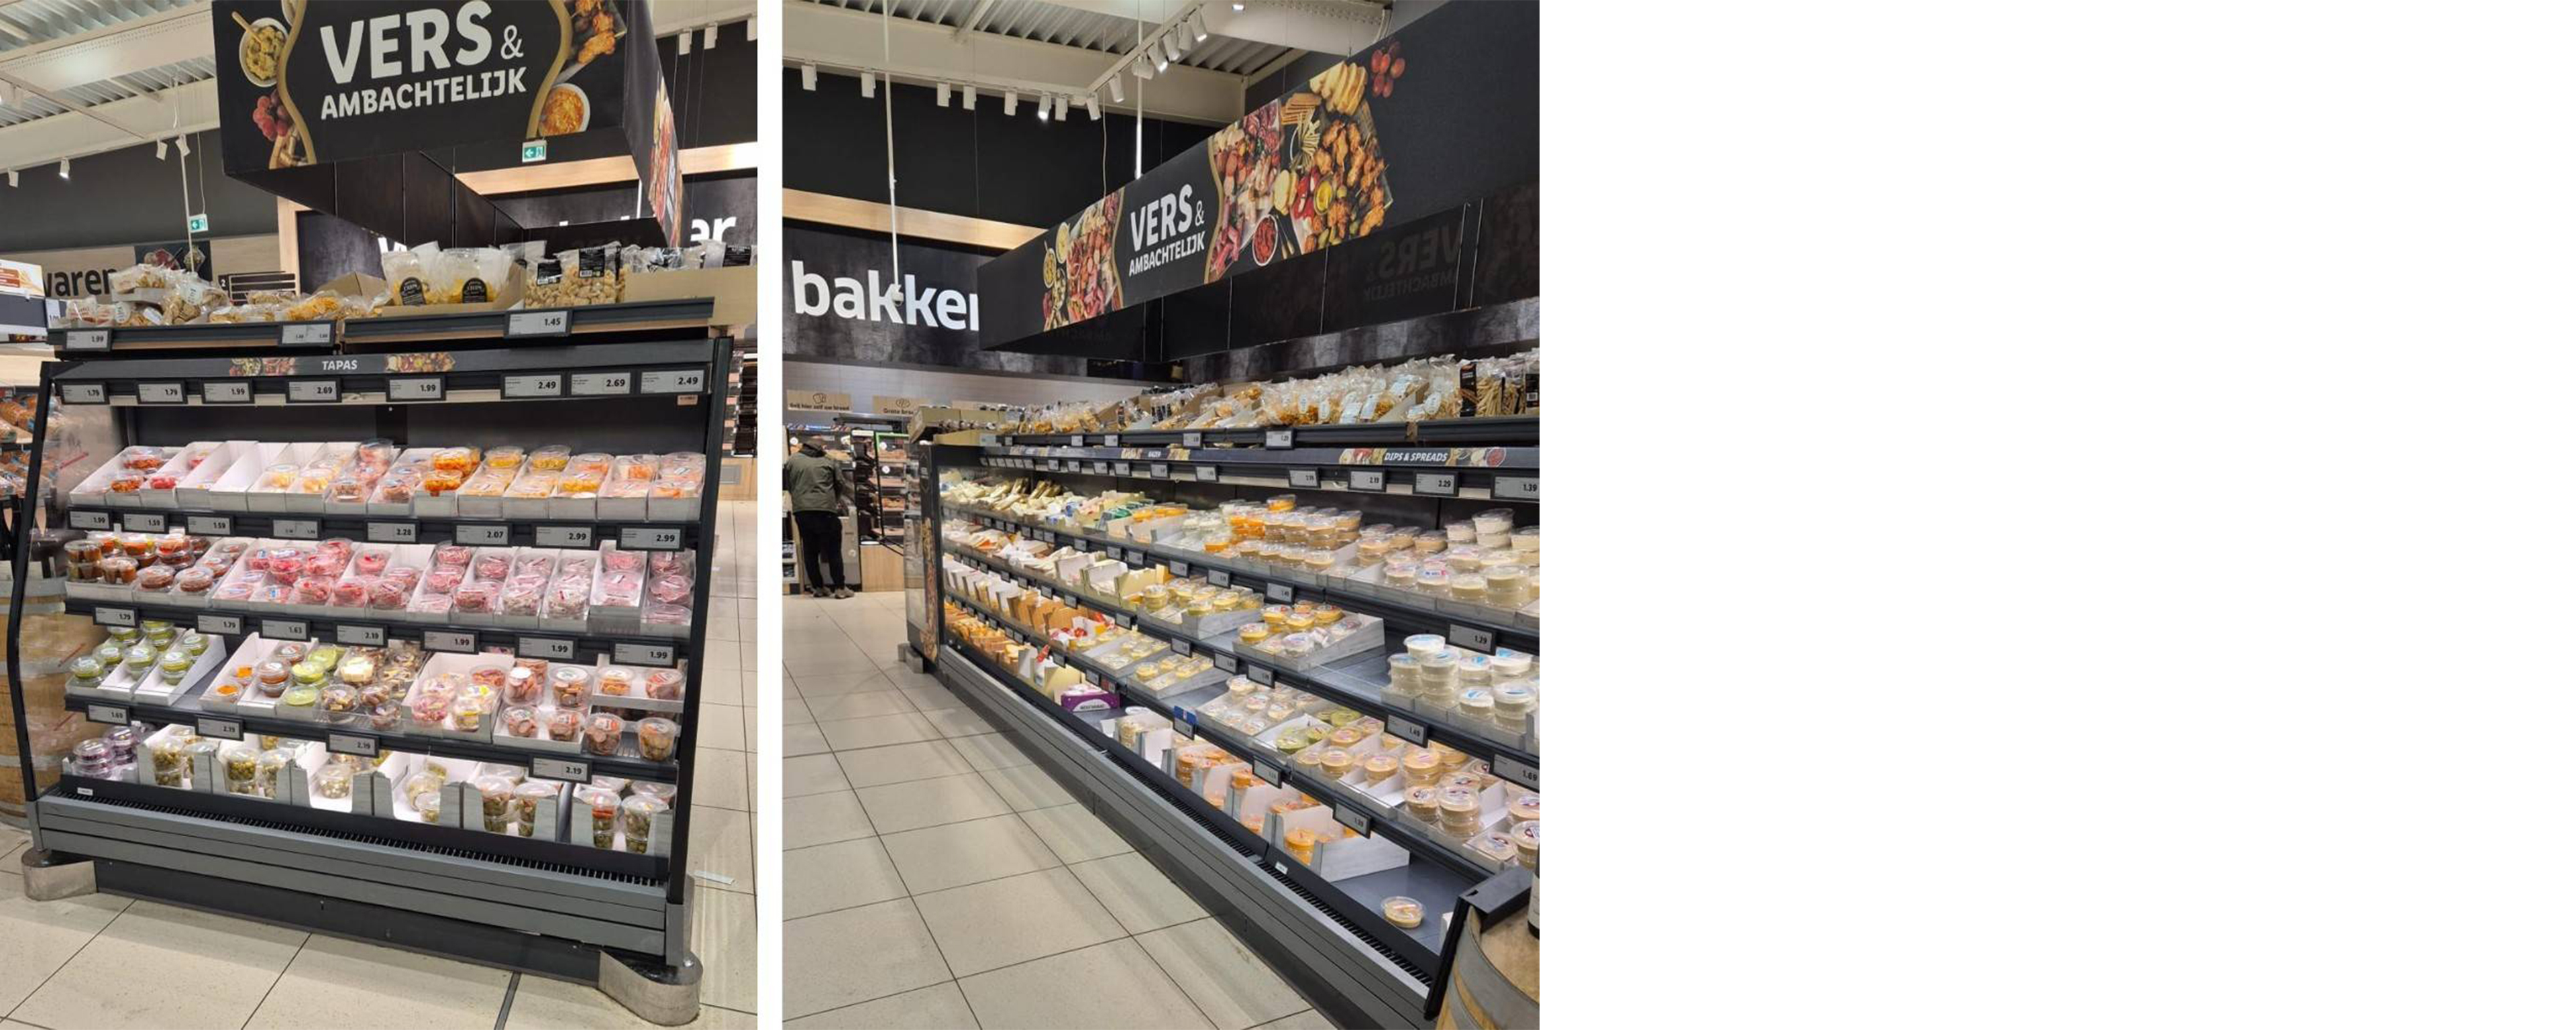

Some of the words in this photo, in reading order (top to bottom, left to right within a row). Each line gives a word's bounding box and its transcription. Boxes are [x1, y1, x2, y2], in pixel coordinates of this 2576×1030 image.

[320, 0, 492, 84] VERS
[500, 25, 525, 60] &
[321, 66, 527, 120] AMBACHTELIJK
[1131, 184, 1193, 252] VERS
[1195, 201, 1205, 227] &
[1128, 231, 1205, 277] AMBACHTELIJK
[544, 318, 561, 326] 1.45
[322, 359, 358, 370] TAPAS
[538, 381, 556, 390] 2.49
[606, 379, 625, 387] 2.69
[678, 377, 698, 385] 2.49
[231, 387, 245, 395] 1.99
[420, 384, 436, 392] 1.99
[1384, 452, 1402, 461] DIPS
[1403, 453, 1409, 461] &
[1410, 453, 1448, 461] SPREADS
[656, 534, 675, 542] 2.99
[454, 638, 470, 646] 1.99
[551, 644, 568, 653] 1.99
[649, 650, 667, 659] 1.99
[566, 766, 582, 775] 2.19
